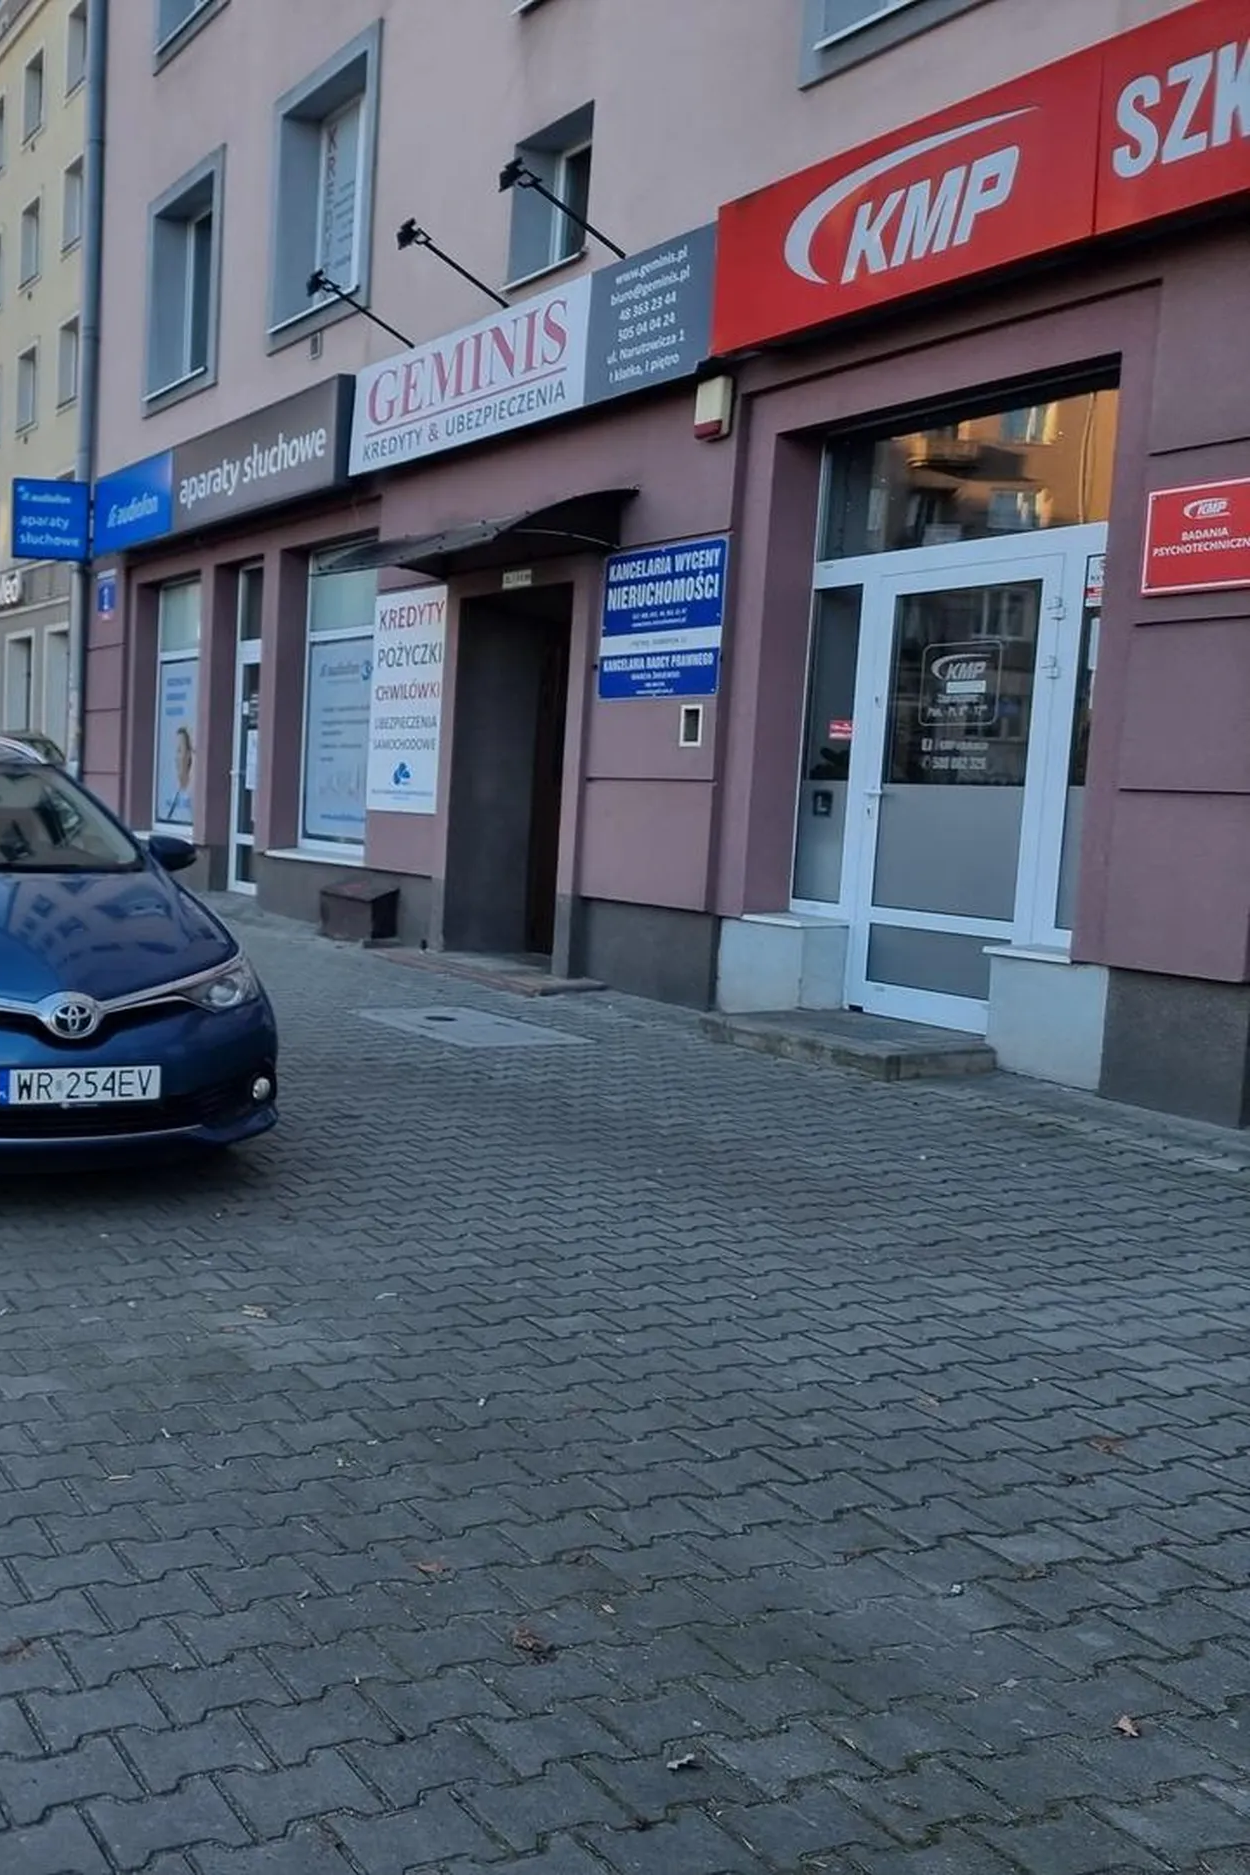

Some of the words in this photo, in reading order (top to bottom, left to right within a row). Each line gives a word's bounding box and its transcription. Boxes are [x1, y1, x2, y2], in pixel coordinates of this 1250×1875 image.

[840, 145, 1020, 285] KMP
[615, 244, 689, 285] www.geminis.pl
[610, 264, 691, 306] biuro@geminis.pl
[367, 299, 568, 426] GEMINIS
[362, 428, 423, 462] KREDYTY
[427, 423, 440, 443] &
[445, 379, 566, 437] UBEZPIECZENIA
[179, 458, 240, 509] aparaty
[242, 427, 327, 483] słuchowe
[21, 515, 70, 531] aparaty
[1181, 527, 1229, 541] BADANIA
[609, 556, 672, 582] KANCELARIA
[675, 548, 722, 572] WYCENY
[607, 570, 720, 612] NIERUCHOMOŚCI
[379, 600, 446, 631] KREDYTY
[377, 640, 442, 669] POŻYCZKI
[603, 657, 645, 672] KANCELARIA
[946, 661, 987, 680] KMP
[375, 679, 440, 702] CHWILÓWKI
[374, 714, 437, 730] UBEZPIECZENIA
[372, 736, 437, 751] SAMOCHODOWE
[17, 1071, 53, 1101] WR
[66, 1069, 152, 1099] 254EV
